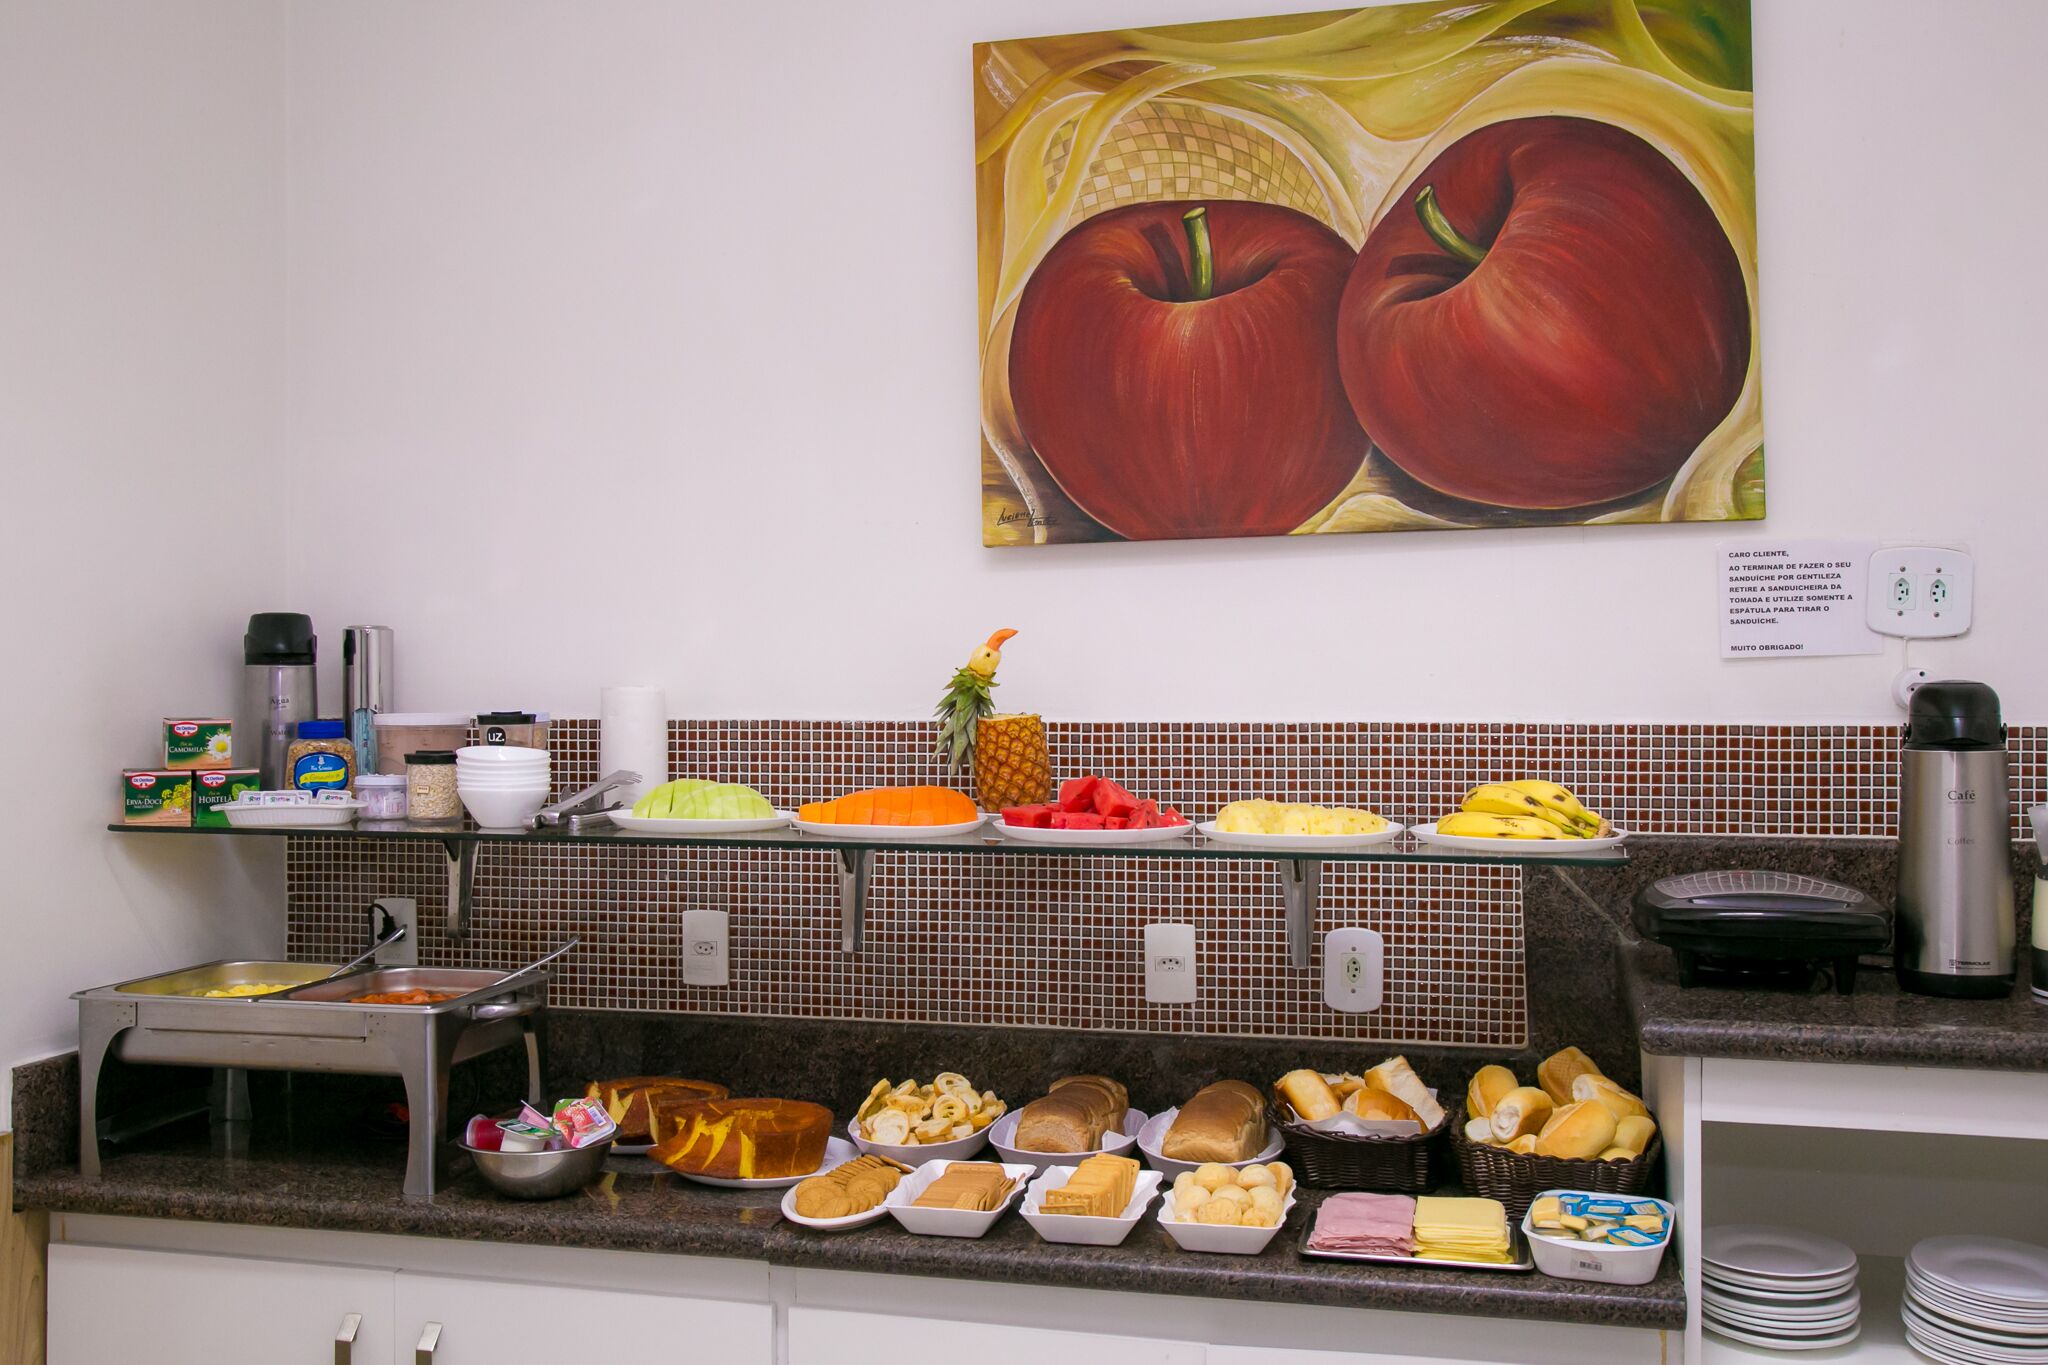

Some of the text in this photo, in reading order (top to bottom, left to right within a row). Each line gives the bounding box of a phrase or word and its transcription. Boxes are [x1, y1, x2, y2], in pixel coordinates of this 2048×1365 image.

[1729, 574, 1776, 582] SANDUÍCHE
[1767, 584, 1829, 592] SANDUICHEIRA
[1806, 594, 1846, 602] SOMENTE
[1947, 790, 1976, 801] Café
